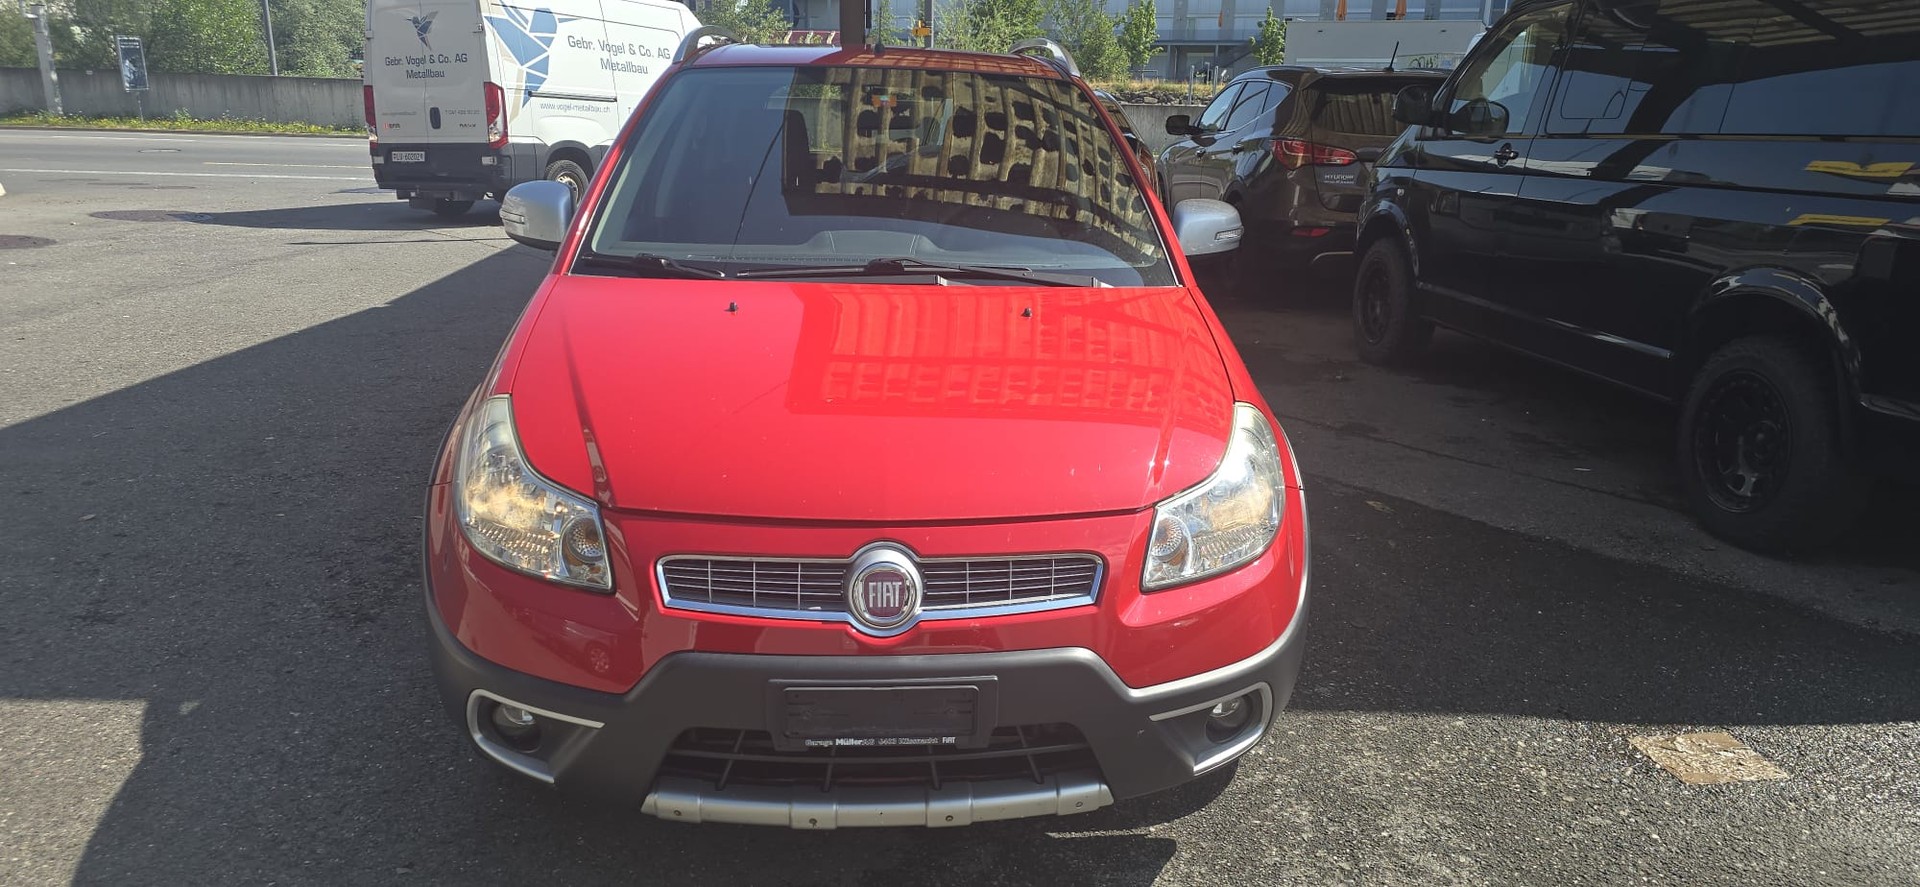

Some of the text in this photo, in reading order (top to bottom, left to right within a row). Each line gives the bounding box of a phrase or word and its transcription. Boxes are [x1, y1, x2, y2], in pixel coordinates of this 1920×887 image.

[567, 35, 671, 59] Gebr. Vogel & Co. AG
[384, 53, 468, 67] Gebr. Vogel & Co. AG
[600, 57, 648, 75] Metallbau
[405, 69, 446, 79] Metallbau
[540, 102, 611, 113] www.vogel-metallbau.ch
[868, 581, 902, 608] FIAT
[835, 738, 862, 746] Müller
[942, 736, 956, 744] FIAT
